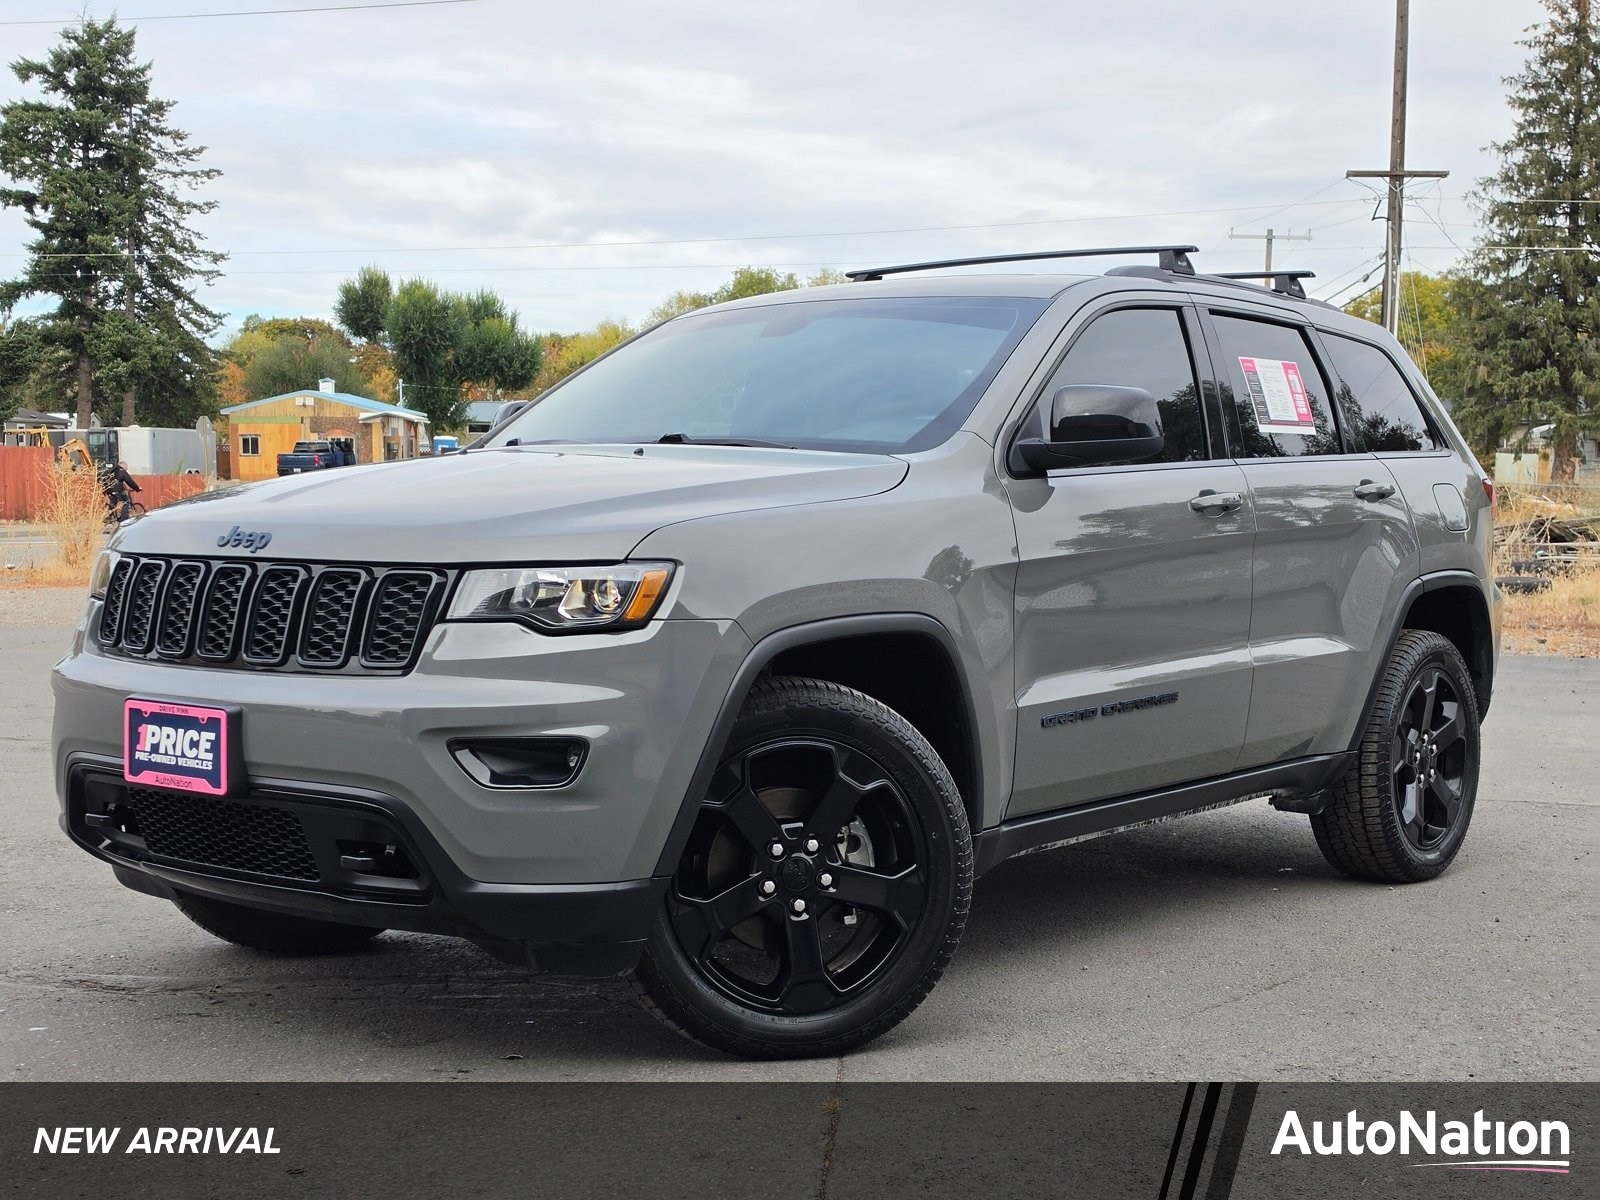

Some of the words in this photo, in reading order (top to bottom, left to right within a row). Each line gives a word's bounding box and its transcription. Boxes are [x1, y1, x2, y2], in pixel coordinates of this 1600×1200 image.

[217, 525, 272, 553] Jeep
[1041, 706, 1098, 728] GRAND
[1101, 691, 1180, 716] CHEROKEE
[135, 751, 177, 765] PRE-OWNED
[177, 757, 213, 771] VEHICLES
[154, 775, 193, 789] AutoNation
